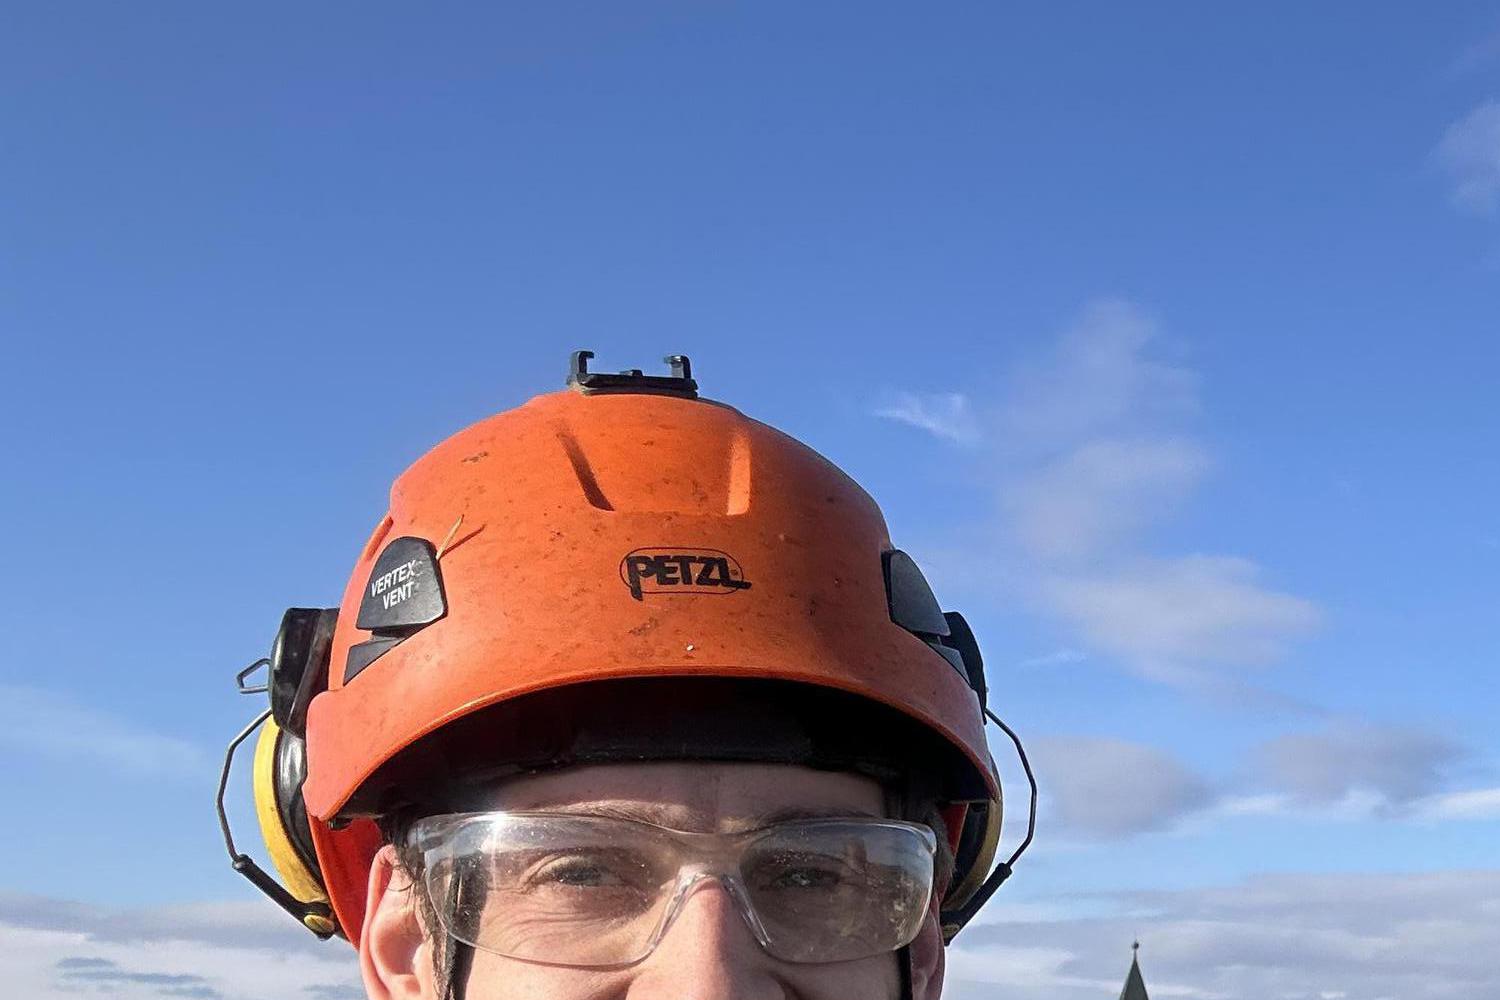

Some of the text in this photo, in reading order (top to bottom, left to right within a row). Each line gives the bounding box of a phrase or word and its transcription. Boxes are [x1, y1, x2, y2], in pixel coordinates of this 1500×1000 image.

[371, 560, 416, 597] VERTEX
[383, 582, 415, 610] VENT
[626, 555, 752, 601] PETZL
